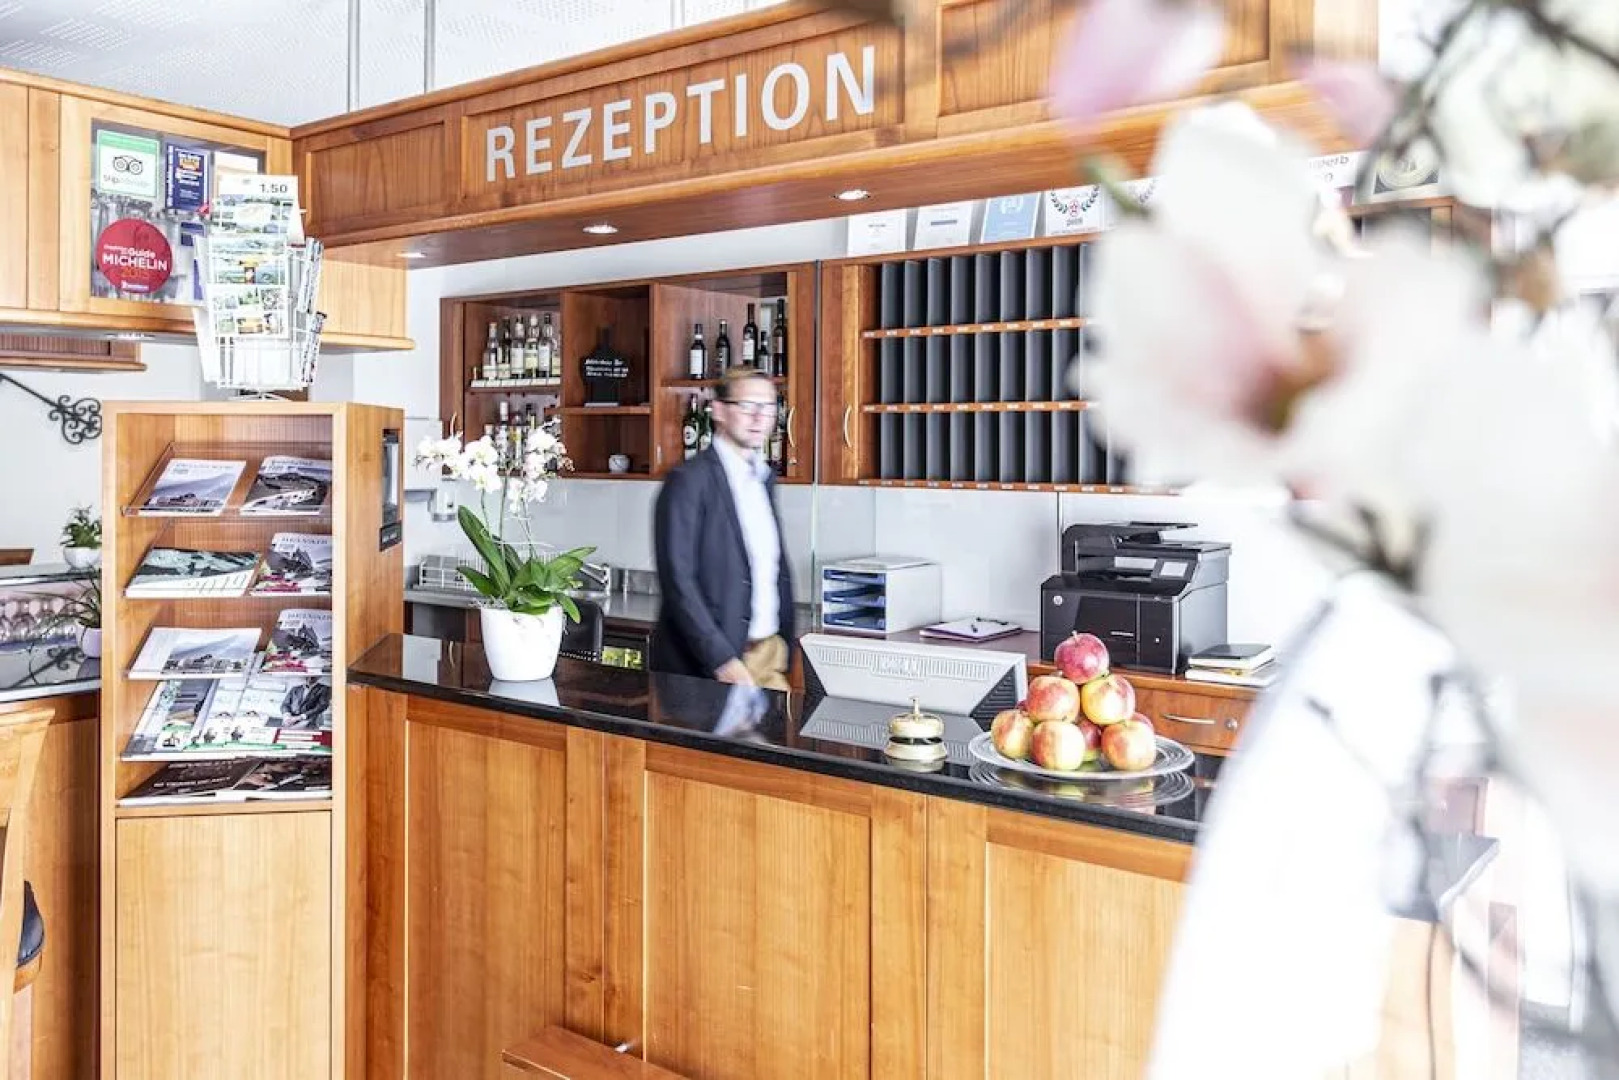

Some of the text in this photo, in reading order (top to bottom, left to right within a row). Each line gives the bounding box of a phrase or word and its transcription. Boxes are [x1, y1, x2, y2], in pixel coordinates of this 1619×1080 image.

[486, 45, 875, 182] REZEPTION
[259, 183, 289, 194] 1.50
[127, 247, 156, 258] Guide
[102, 252, 168, 271] MICHELIN
